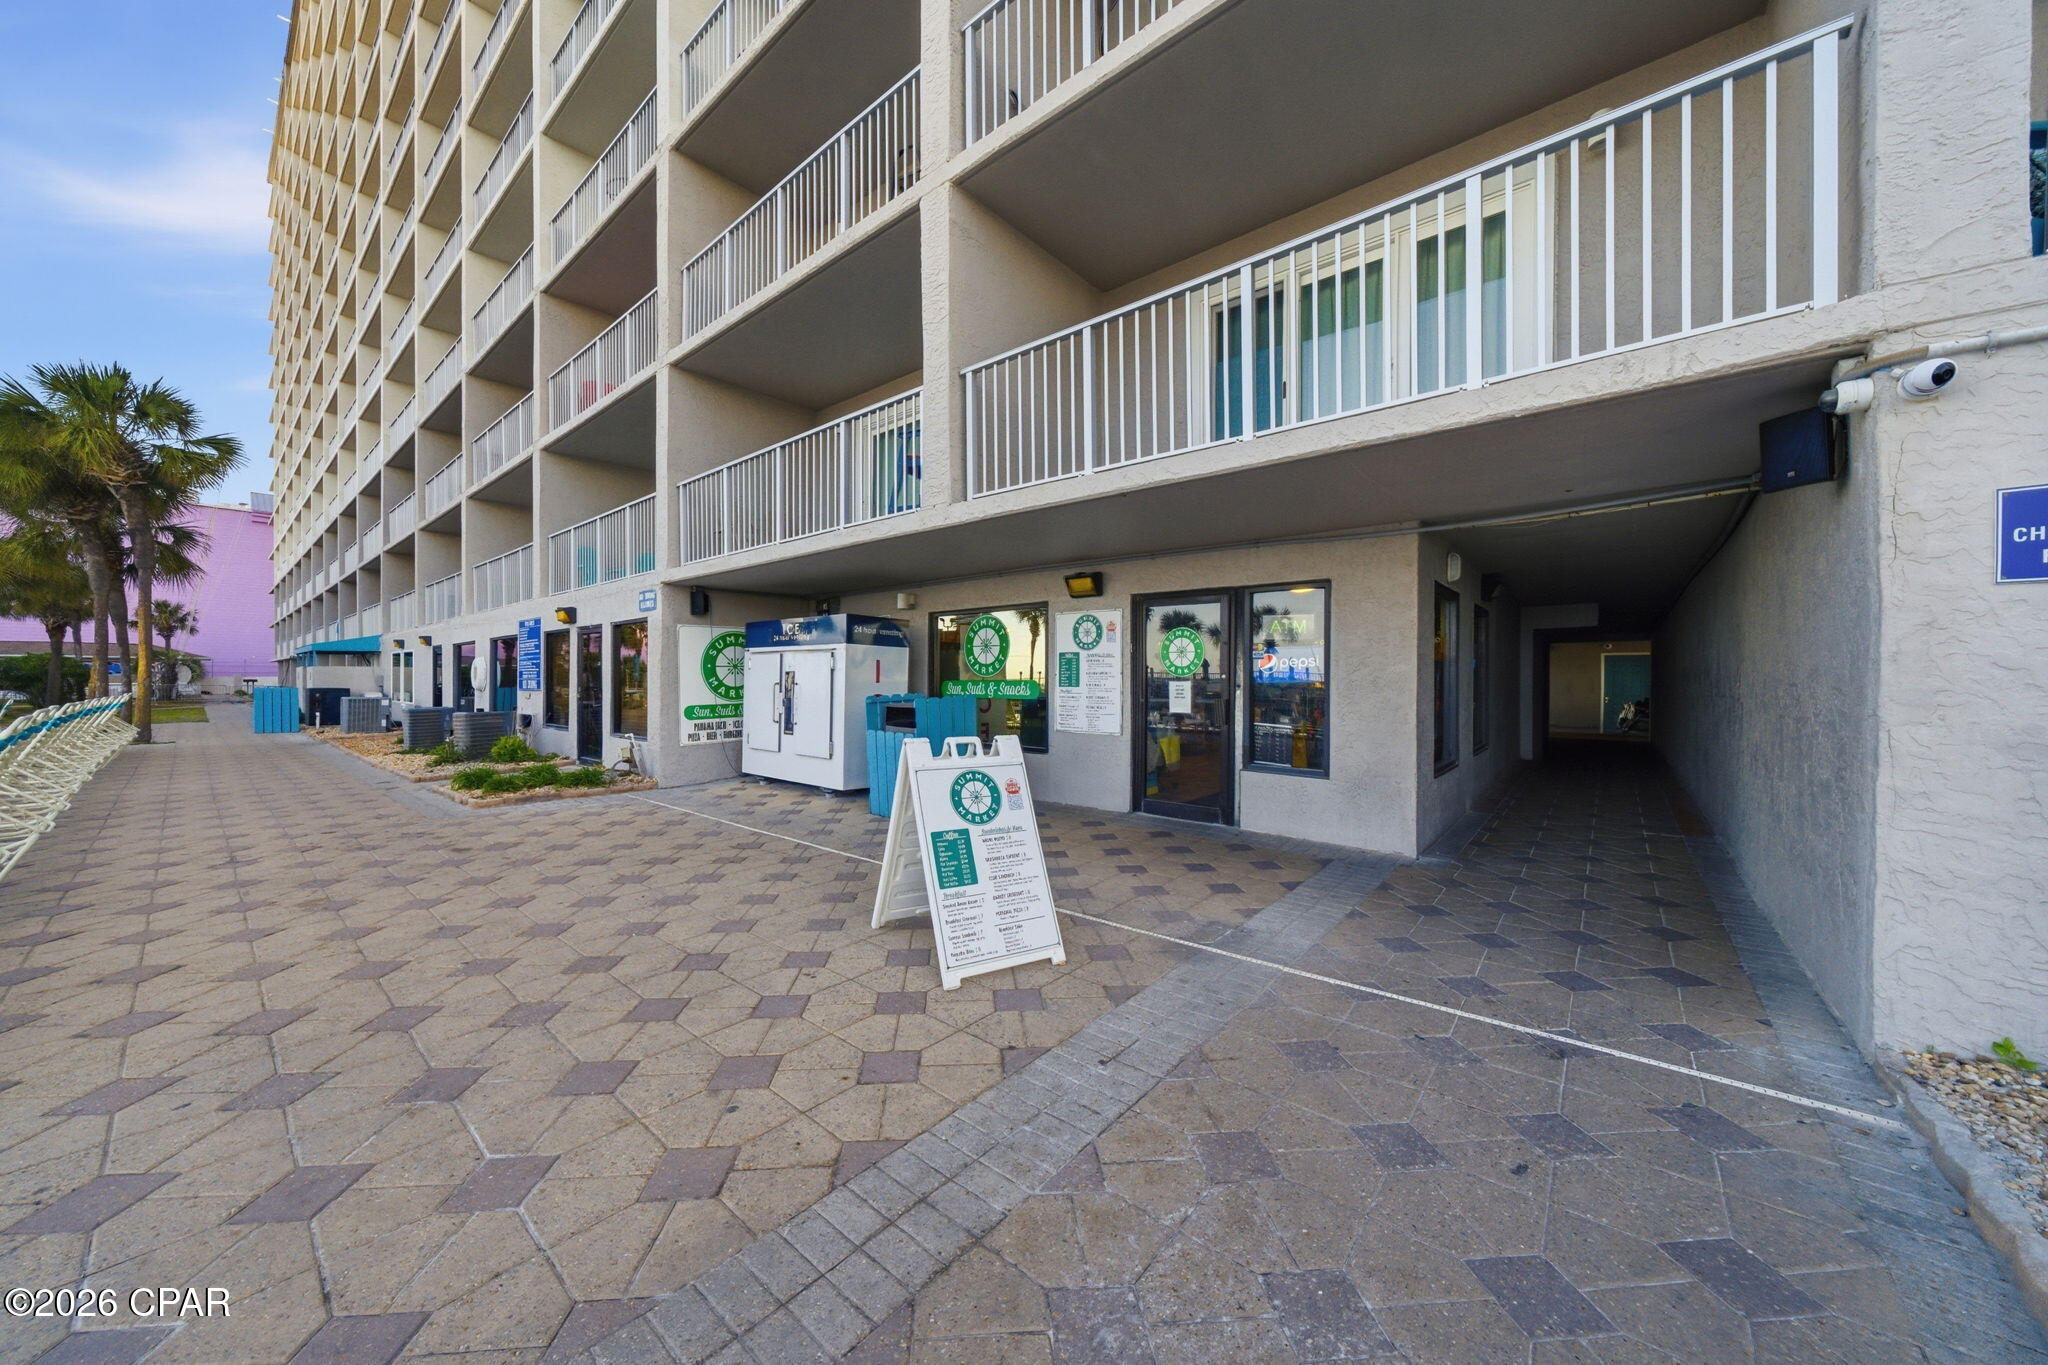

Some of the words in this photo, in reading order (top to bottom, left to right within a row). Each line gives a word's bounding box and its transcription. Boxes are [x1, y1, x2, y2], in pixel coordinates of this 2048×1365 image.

[2013, 526, 2046, 542] CH
[782, 623, 800, 635] ICE
[969, 618, 1006, 637] SUMMIT
[1270, 618, 1307, 634] ATM
[1164, 630, 1201, 645] SUMMIT
[968, 654, 1005, 674] MARKET
[1163, 658, 1201, 675] MARKET
[1280, 655, 1320, 670] pepsi
[966, 681, 986, 696] Suds
[987, 682, 998, 698] &
[998, 681, 1031, 696] Snacks
[715, 704, 736, 717] Suds
[954, 772, 995, 791] SUMMIT
[958, 803, 998, 823] MARKET
